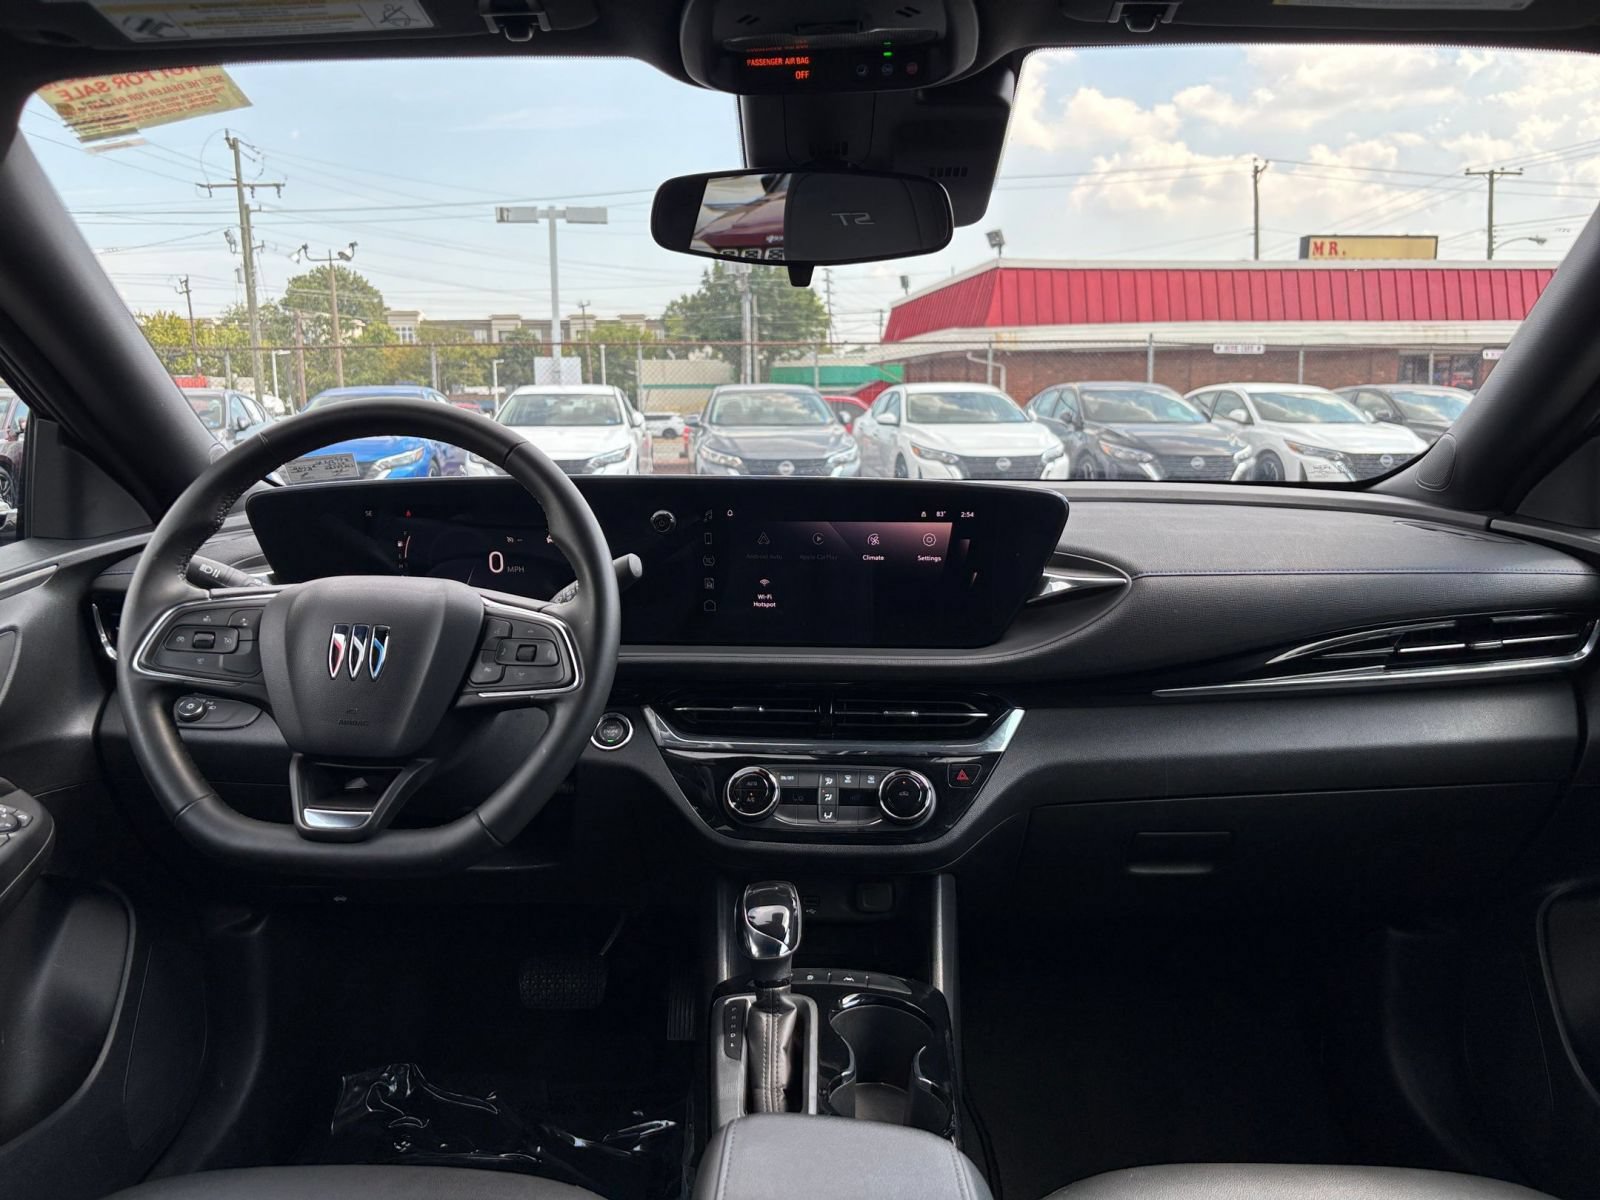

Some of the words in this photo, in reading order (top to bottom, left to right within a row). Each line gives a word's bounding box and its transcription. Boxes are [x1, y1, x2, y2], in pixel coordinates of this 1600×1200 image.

[746, 57, 783, 66] PASSENGER
[785, 57, 795, 65] AIR
[796, 56, 809, 65] BAG
[795, 70, 809, 80] OFF
[1312, 241, 1346, 256] MR.
[488, 550, 504, 574] 0
[507, 565, 525, 574] MPH
[917, 554, 942, 563] Settings
[753, 601, 776, 609] Hotspot
